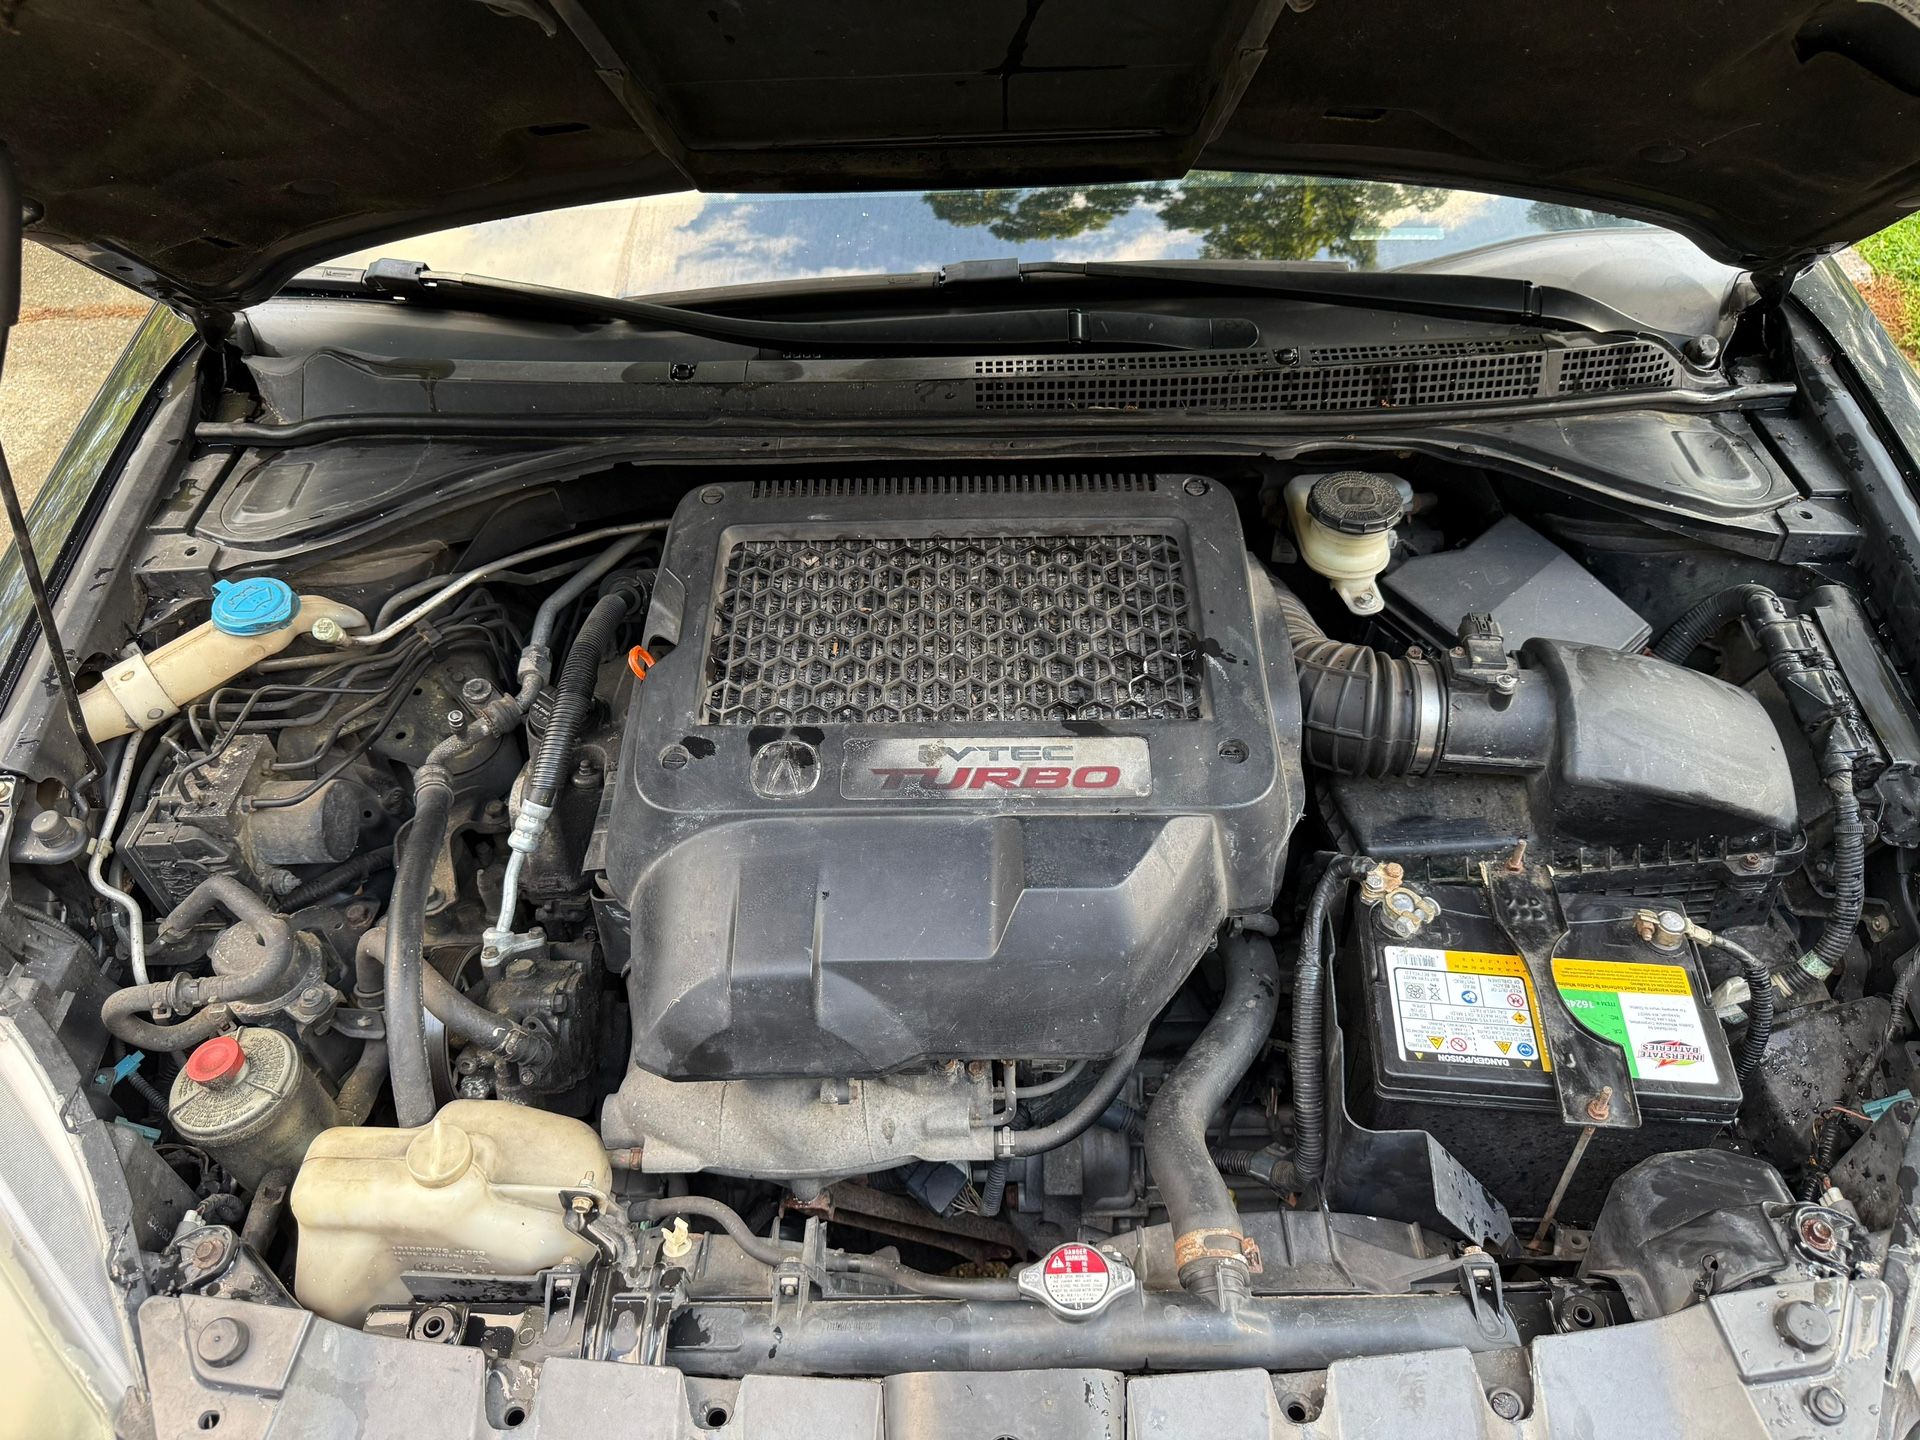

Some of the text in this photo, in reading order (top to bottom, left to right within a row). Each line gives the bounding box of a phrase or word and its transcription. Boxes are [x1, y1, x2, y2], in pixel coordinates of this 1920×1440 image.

[870, 766, 1120, 790] TURBO
[1641, 1044, 1700, 1054] BATTERIES
[1437, 1054, 1510, 1066] DANGER/POISON
[1638, 1050, 1704, 1062] INTERSTATE
